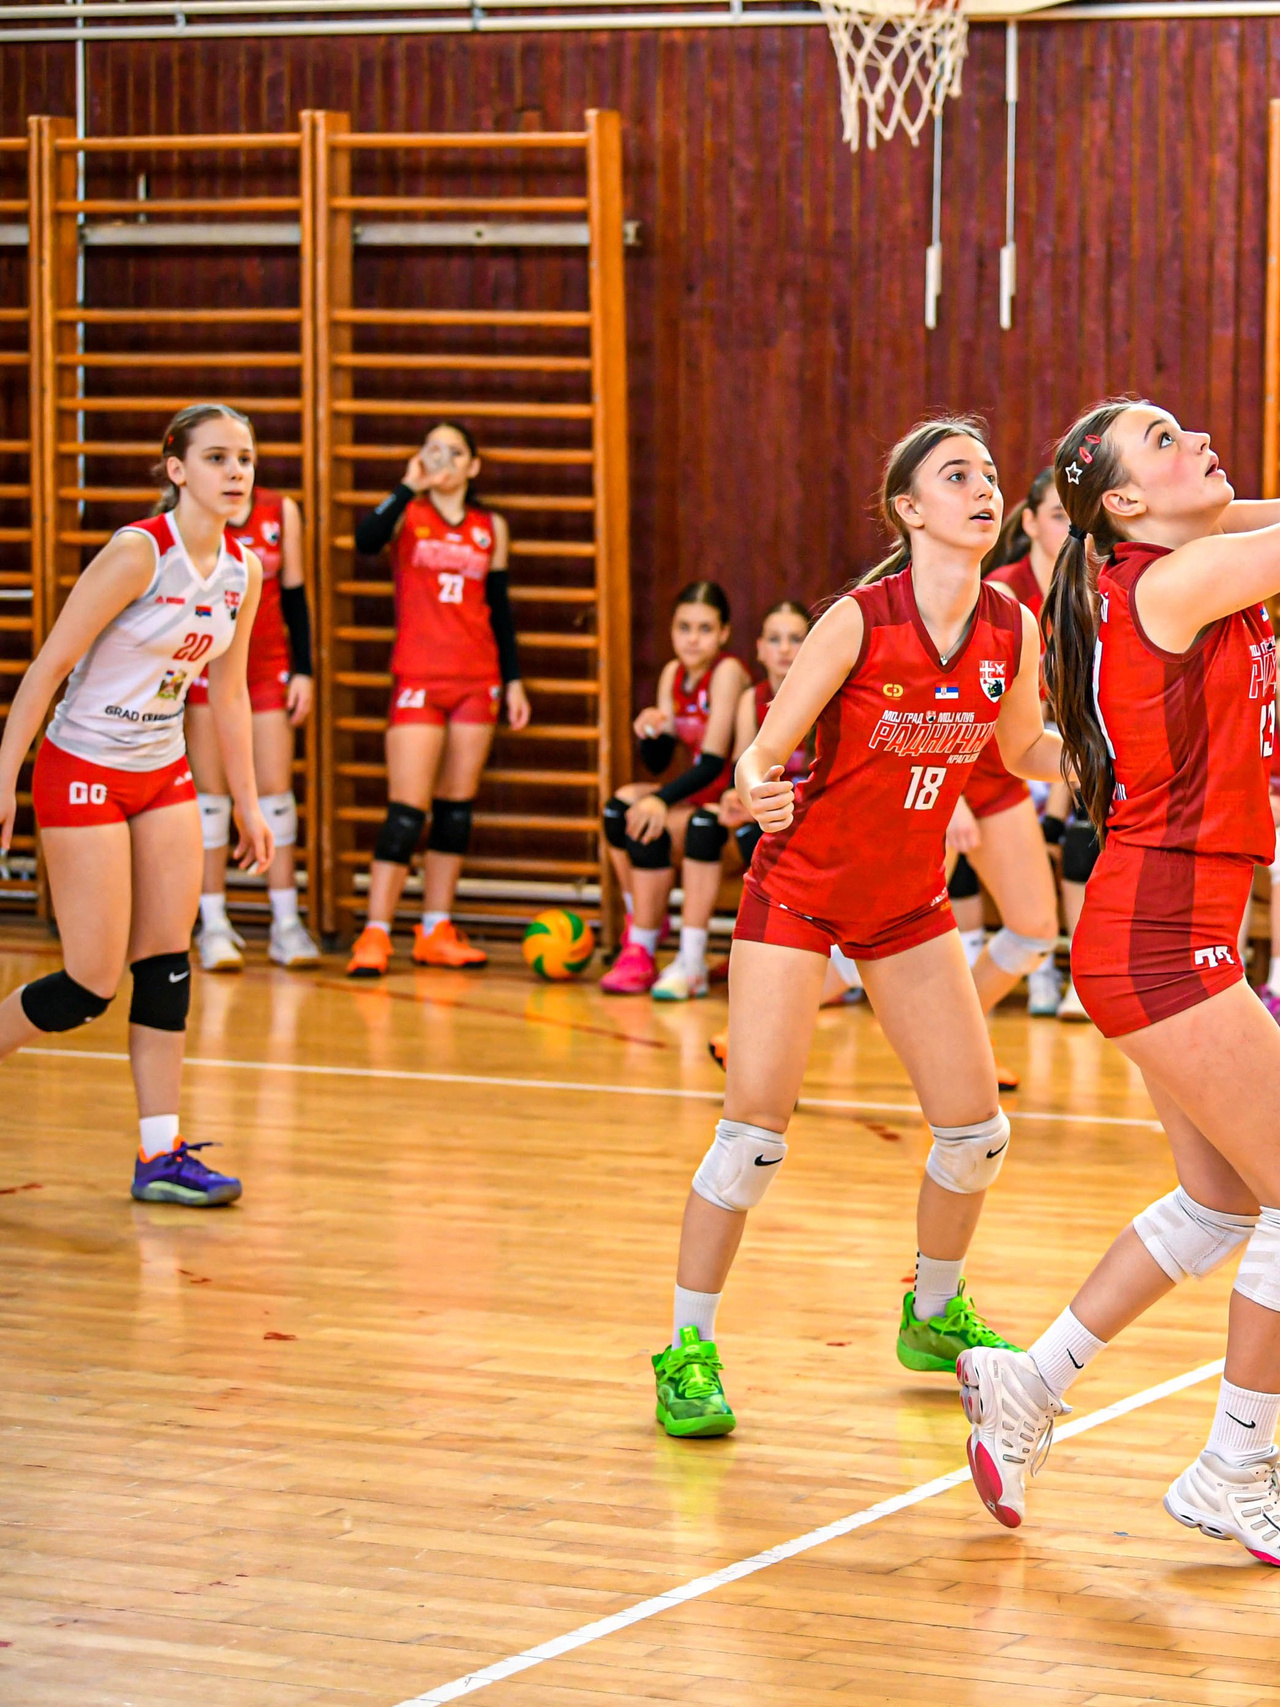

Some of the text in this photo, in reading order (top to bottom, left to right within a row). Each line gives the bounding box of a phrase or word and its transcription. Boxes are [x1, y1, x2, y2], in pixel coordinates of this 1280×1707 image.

[172, 632, 214, 662] 20
[104, 705, 140, 722] GRAD
[903, 766, 948, 810] 18
